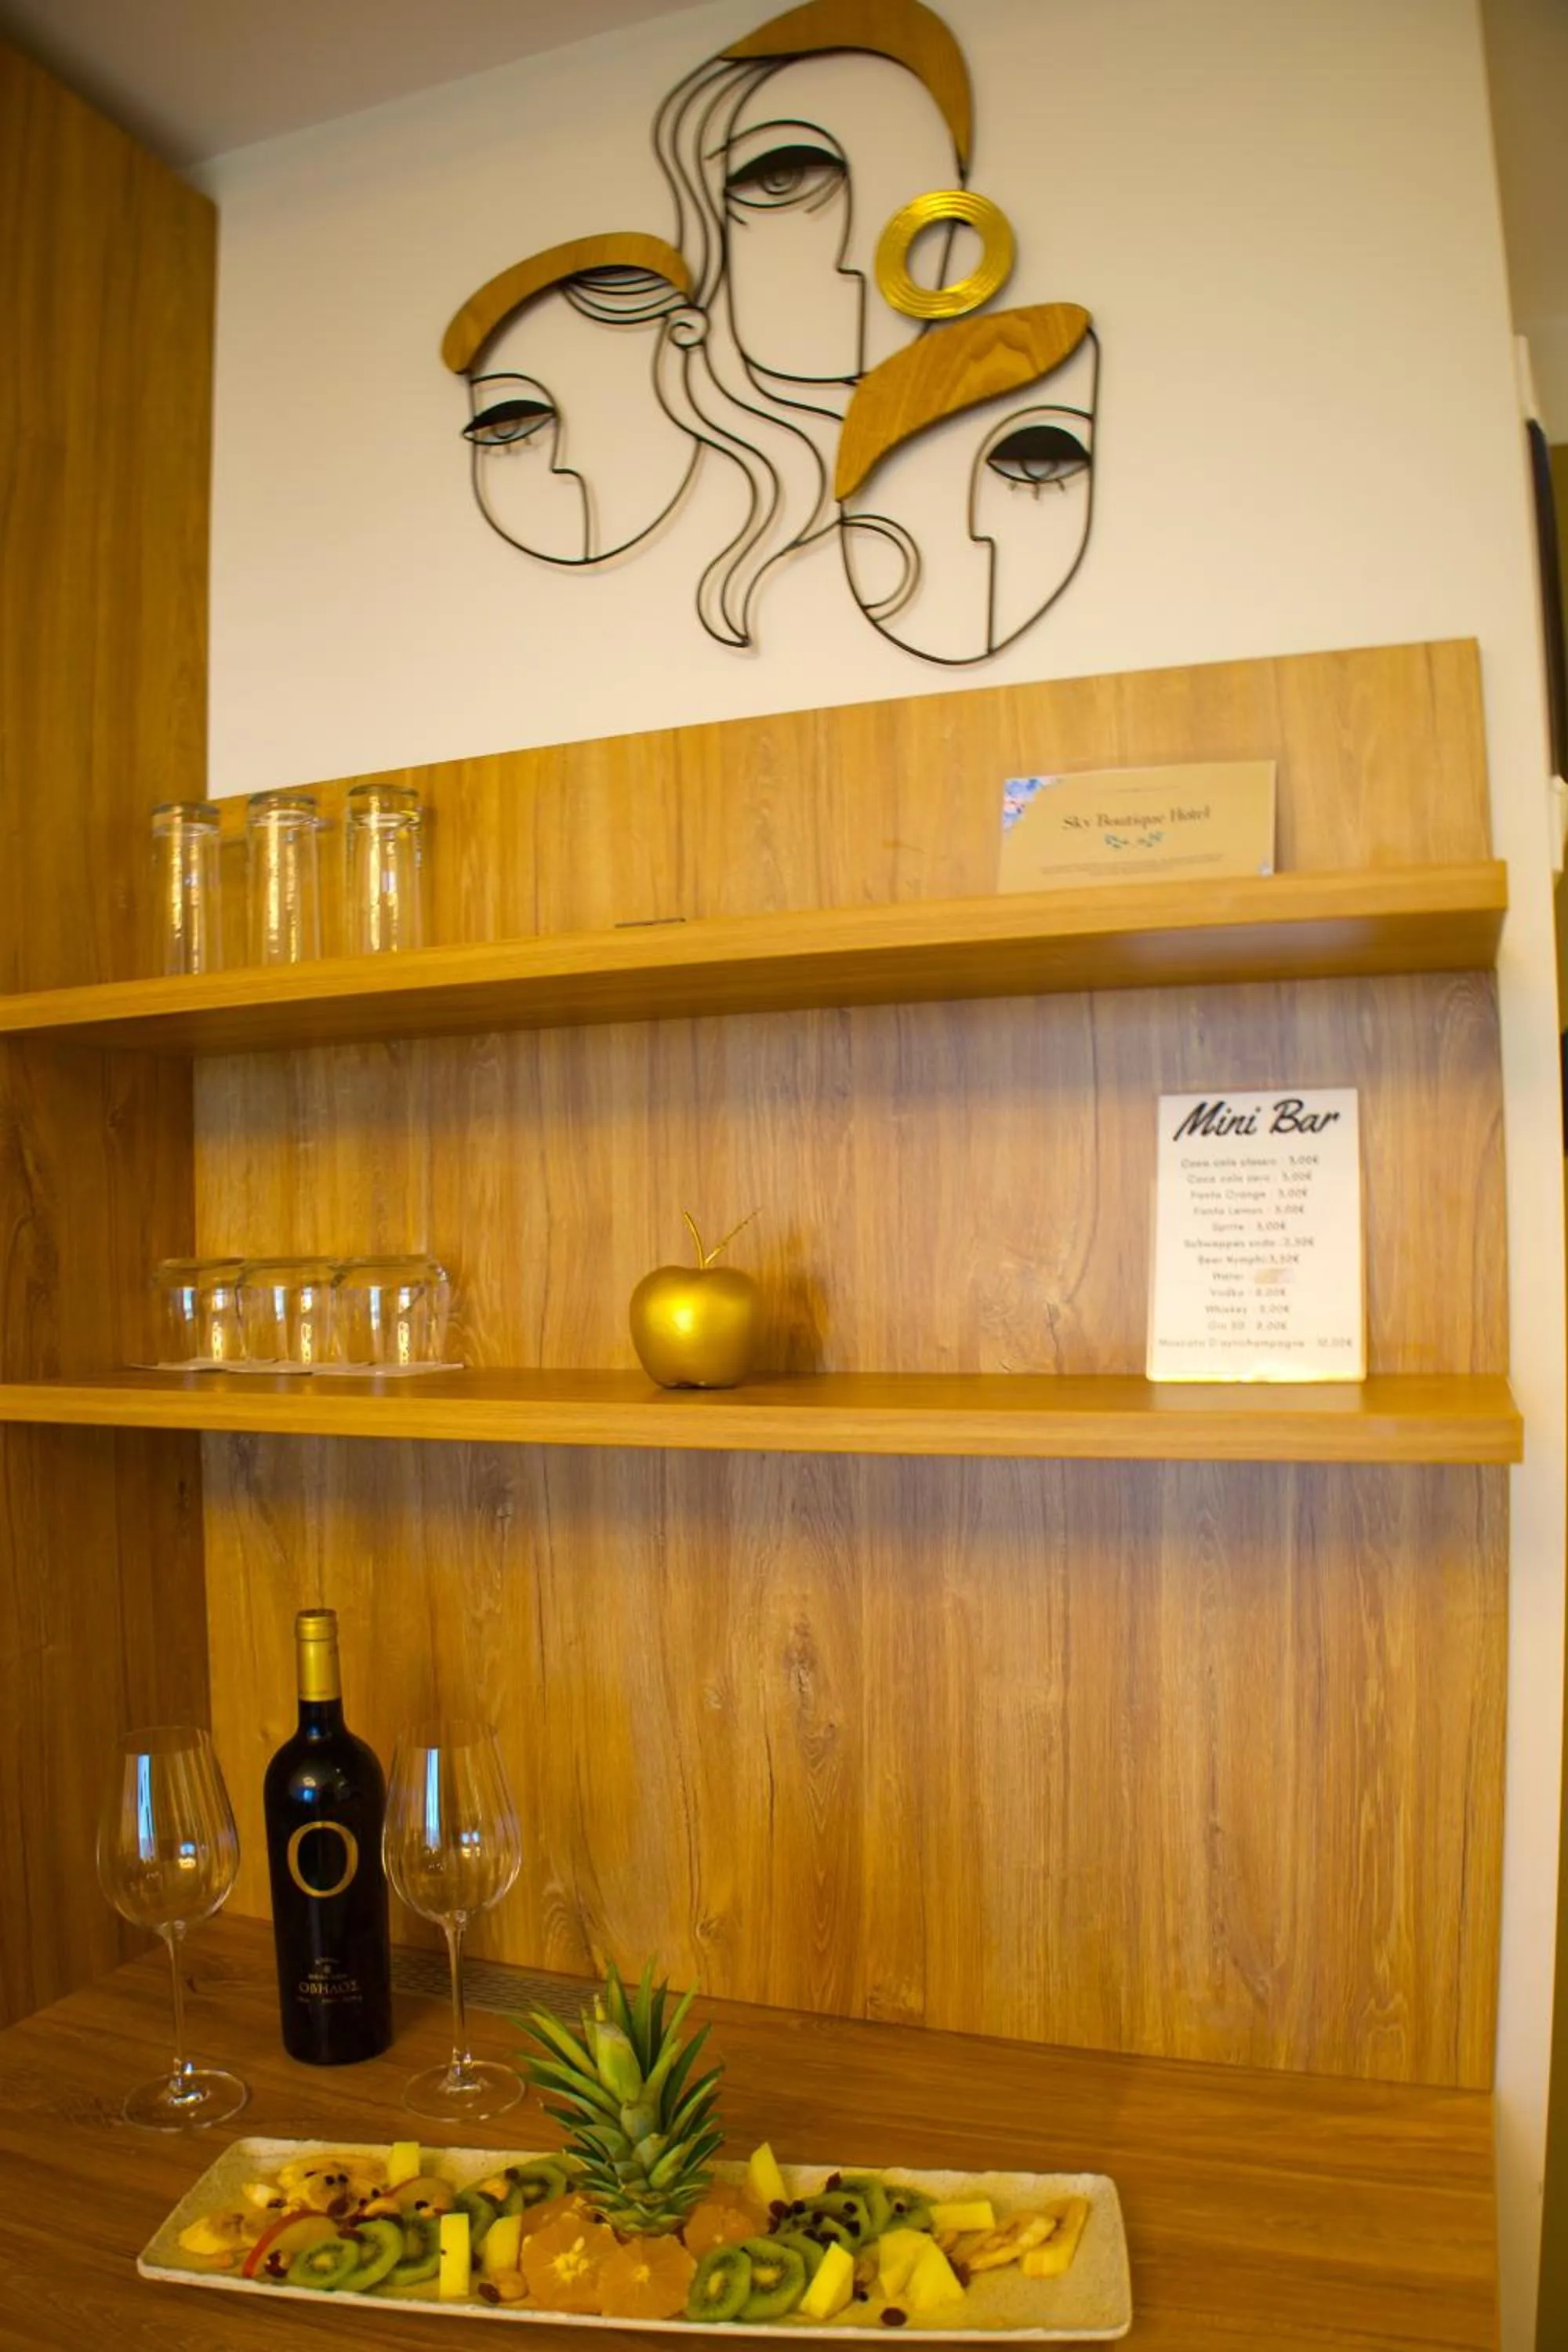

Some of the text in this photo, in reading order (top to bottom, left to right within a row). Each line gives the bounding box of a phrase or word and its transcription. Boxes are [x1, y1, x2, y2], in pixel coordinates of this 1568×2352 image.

[1098, 811, 1165, 829] Boutique
[1170, 804, 1211, 823] Hotel
[1172, 1098, 1341, 1142] Mini Bar
